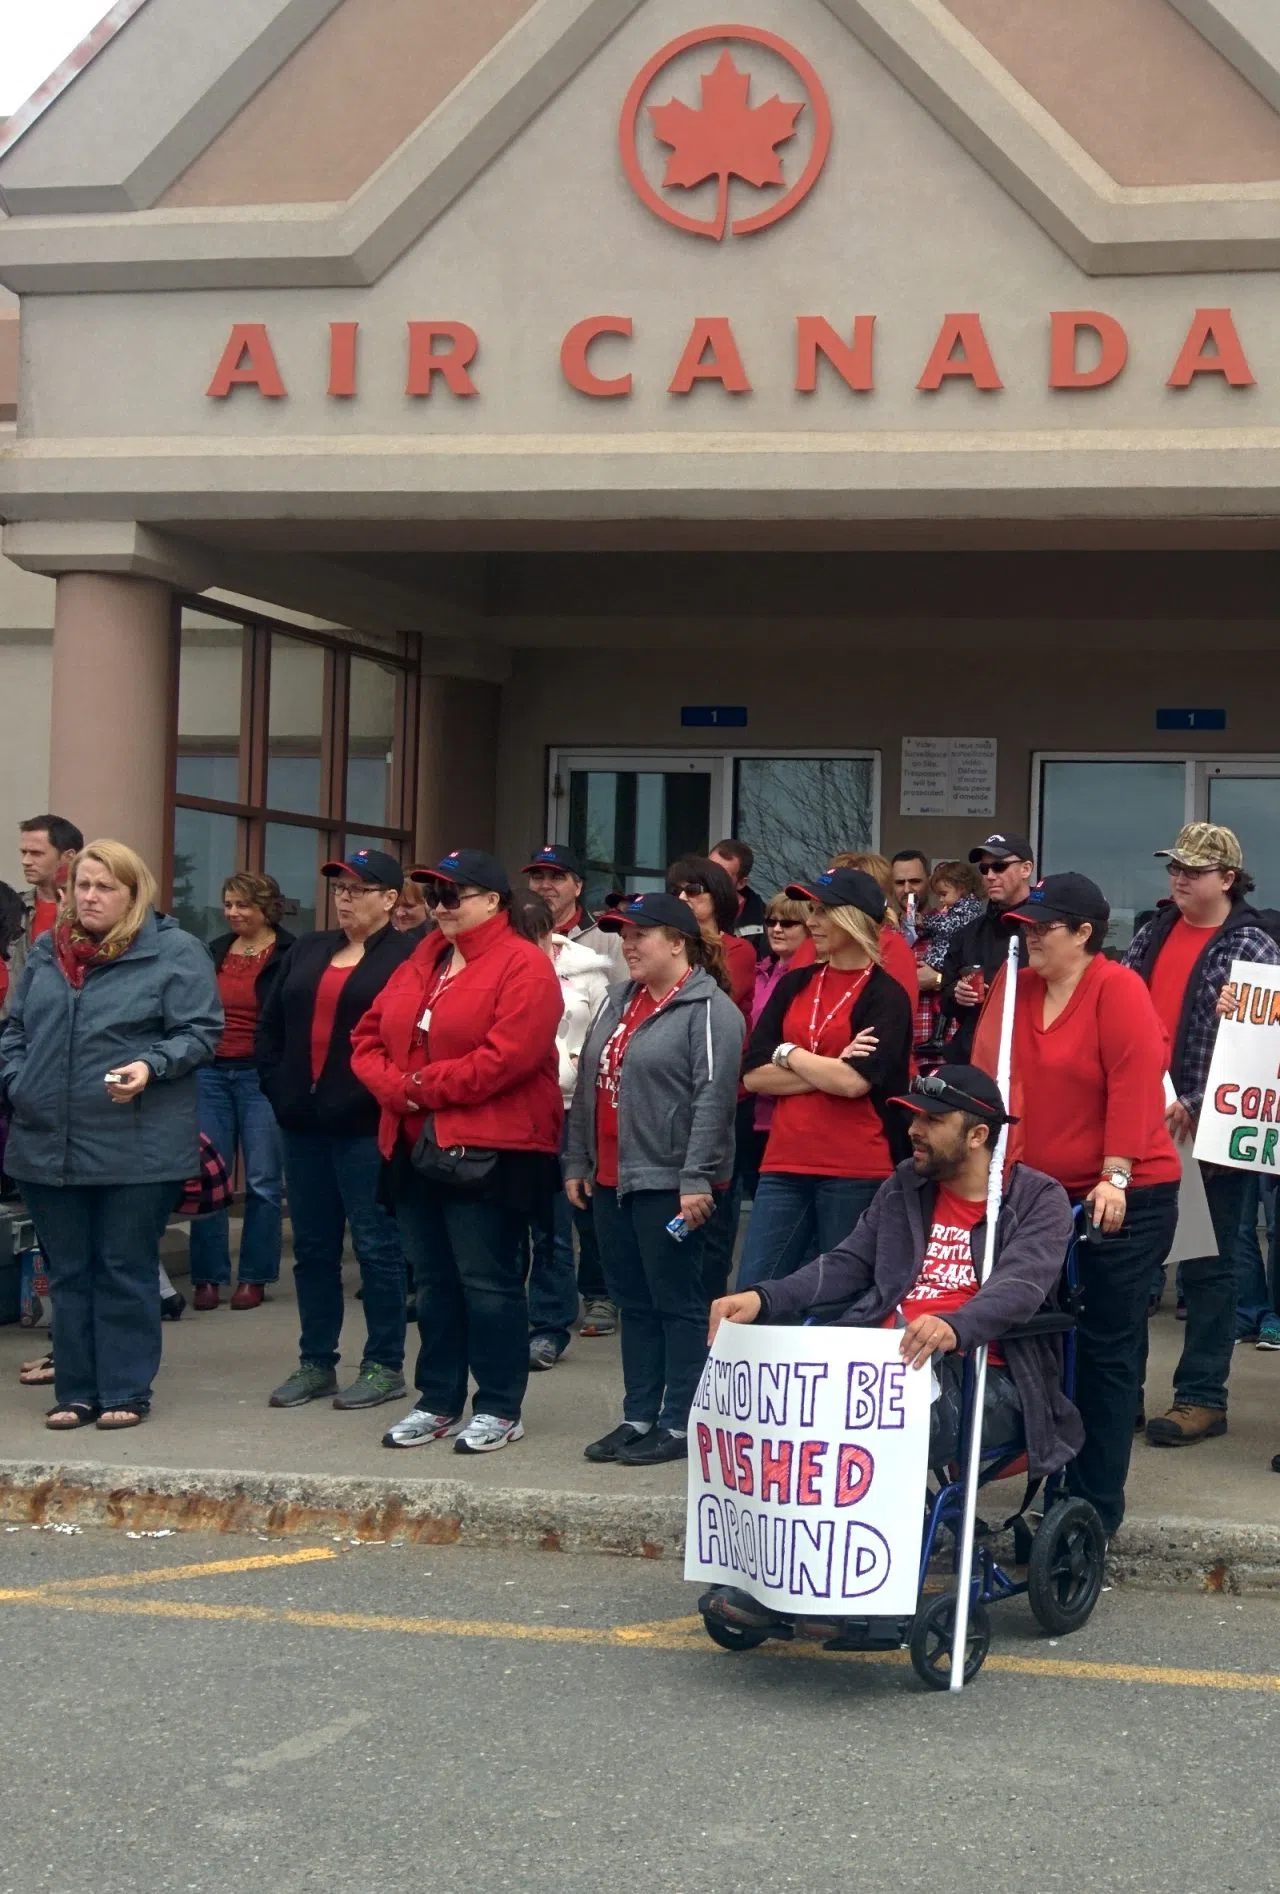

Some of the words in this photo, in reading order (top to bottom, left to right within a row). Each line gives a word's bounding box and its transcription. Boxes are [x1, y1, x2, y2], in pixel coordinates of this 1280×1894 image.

[205, 320, 480, 398] AIR
[560, 307, 1256, 398] CANADA
[709, 709, 718, 723] 1
[1187, 712, 1196, 727] 1
[714, 1360, 828, 1428] WONT
[845, 1361, 907, 1430] BE
[696, 1421, 875, 1508] PUSHED
[697, 1494, 891, 1598] AROUND
